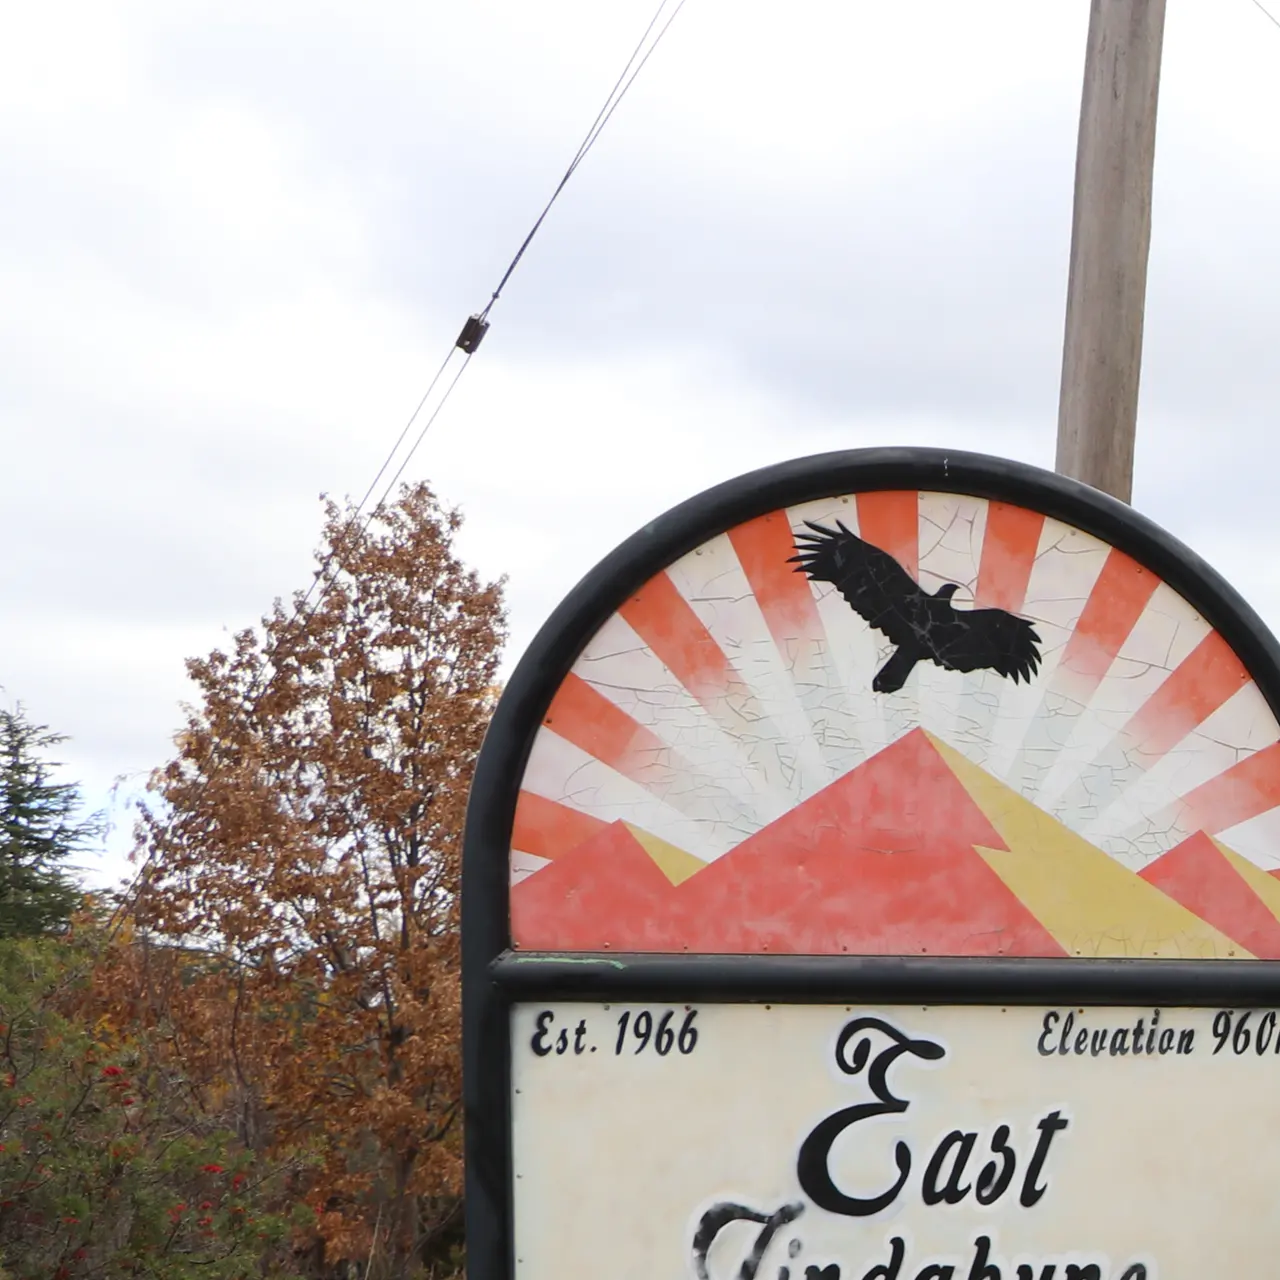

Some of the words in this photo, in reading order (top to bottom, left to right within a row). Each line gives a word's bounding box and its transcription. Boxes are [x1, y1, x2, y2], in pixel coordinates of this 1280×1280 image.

[530, 1009, 598, 1057] Est.
[615, 1009, 699, 1056] 1966
[1036, 1009, 1196, 1057] Elevation
[797, 1016, 1069, 1217] East
